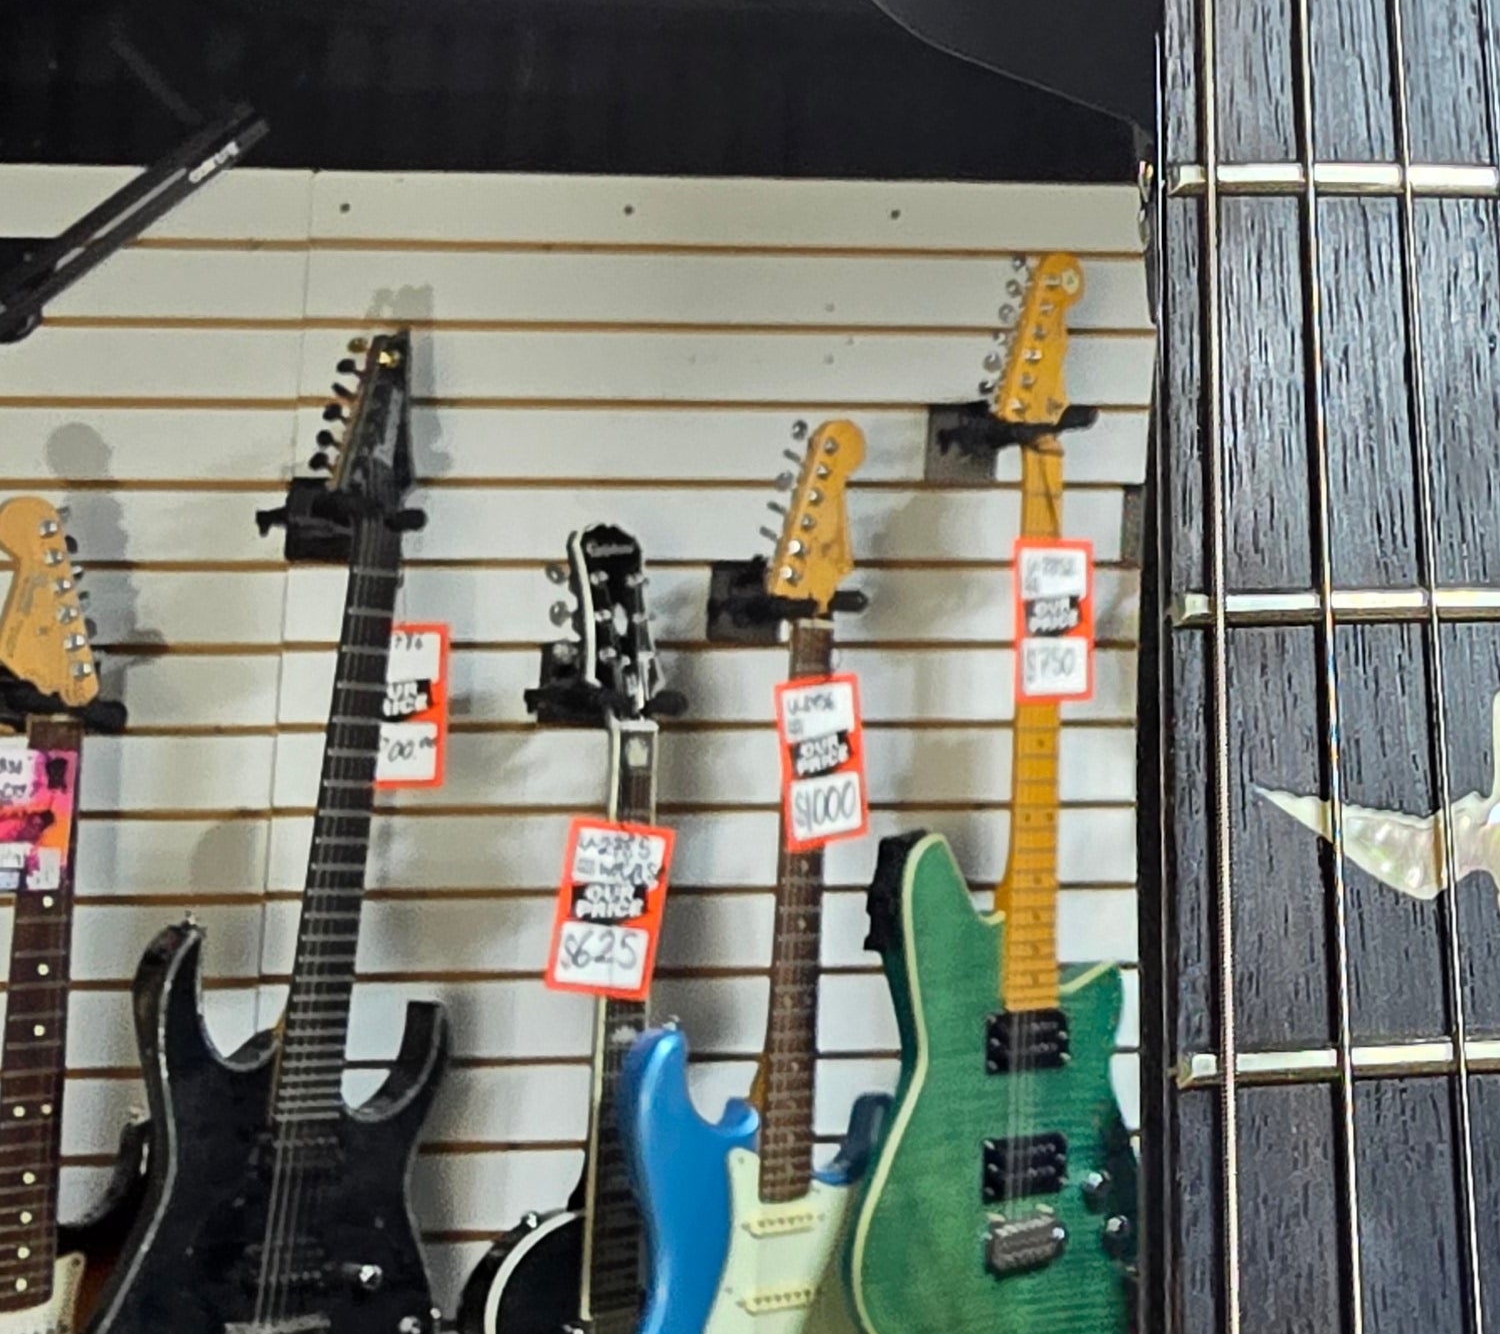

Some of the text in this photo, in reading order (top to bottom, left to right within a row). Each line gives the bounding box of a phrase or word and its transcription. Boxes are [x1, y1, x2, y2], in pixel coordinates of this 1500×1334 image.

[386, 681, 418, 700] UR
[799, 733, 841, 759] OUR
[796, 744, 850, 778] PRICE
[794, 780, 857, 833] $1000
[584, 883, 636, 905] OUR
[575, 896, 645, 919] PRICE
